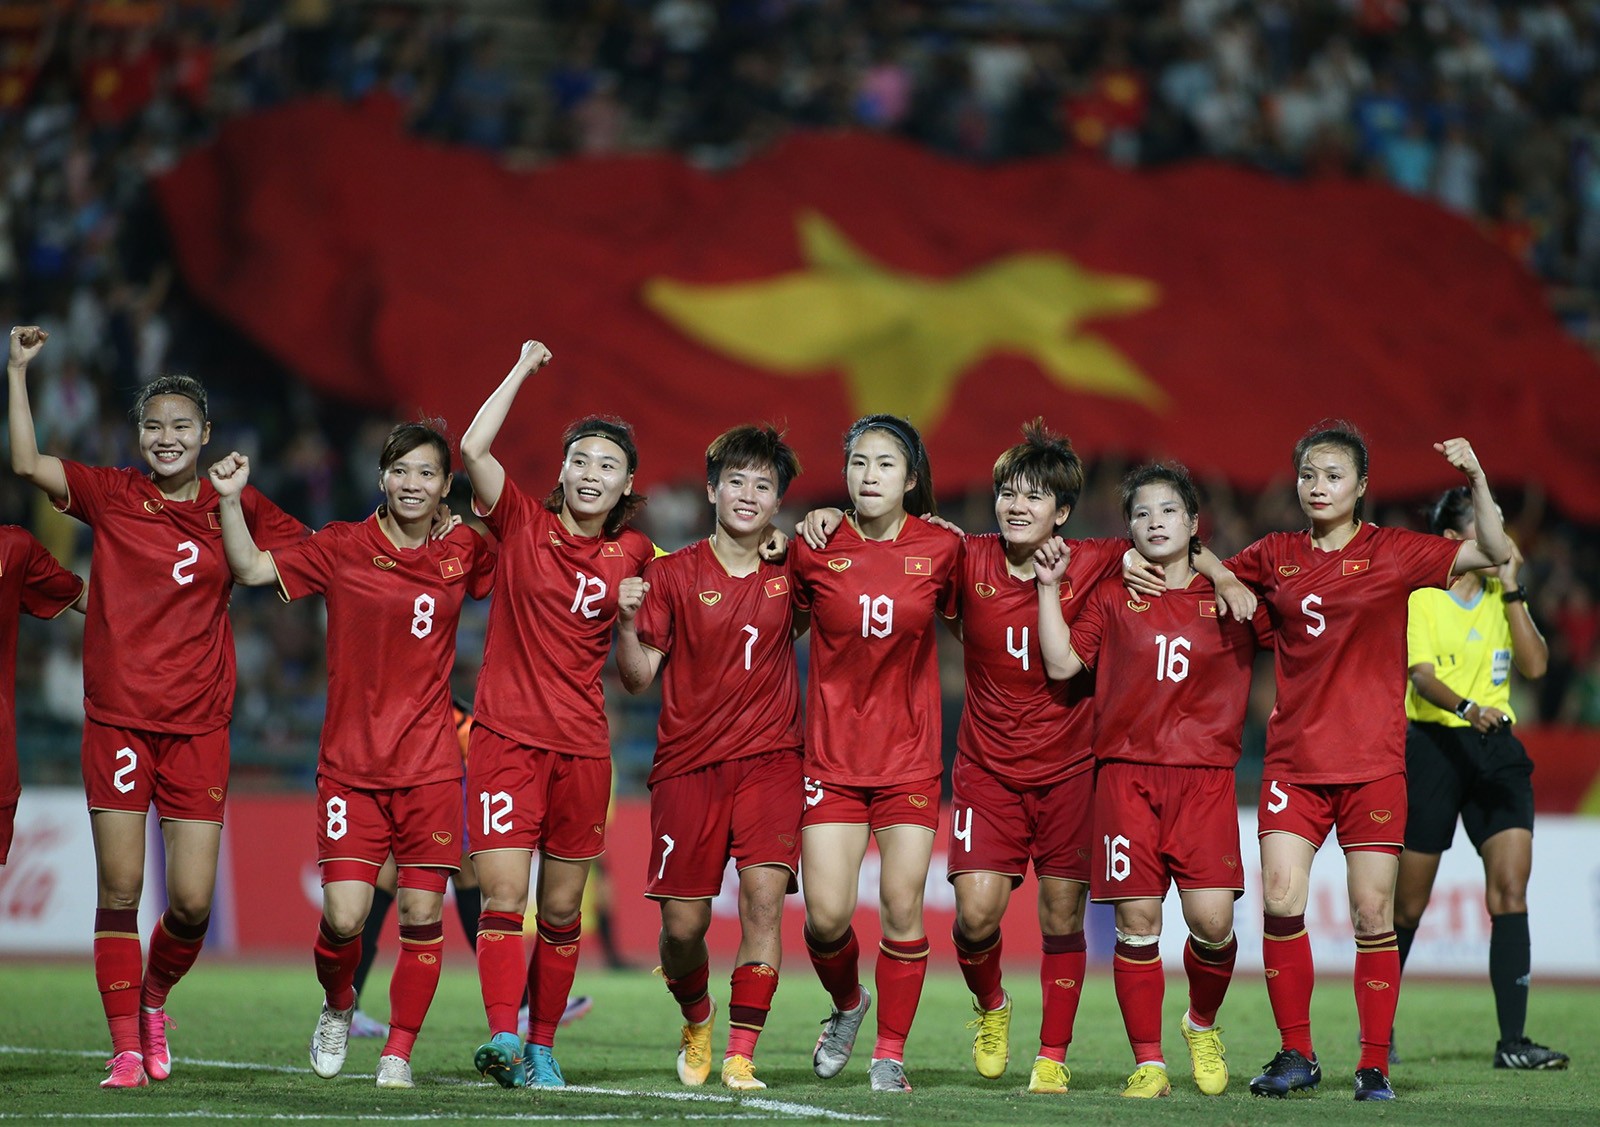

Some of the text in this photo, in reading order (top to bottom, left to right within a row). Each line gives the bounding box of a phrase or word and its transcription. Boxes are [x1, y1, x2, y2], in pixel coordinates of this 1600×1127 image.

[172, 540, 200, 586] 2
[410, 592, 436, 640] 8
[570, 571, 608, 619] 12
[858, 593, 895, 639] 19
[1301, 593, 1326, 638] 5
[739, 623, 759, 671] 7
[1006, 625, 1030, 671] 4
[1154, 633, 1192, 683] 16
[113, 746, 138, 794] 2
[326, 795, 348, 841] 8
[479, 790, 514, 836] 12
[953, 806, 973, 853] 4
[657, 833, 675, 880] 7
[1103, 834, 1131, 881] 16
